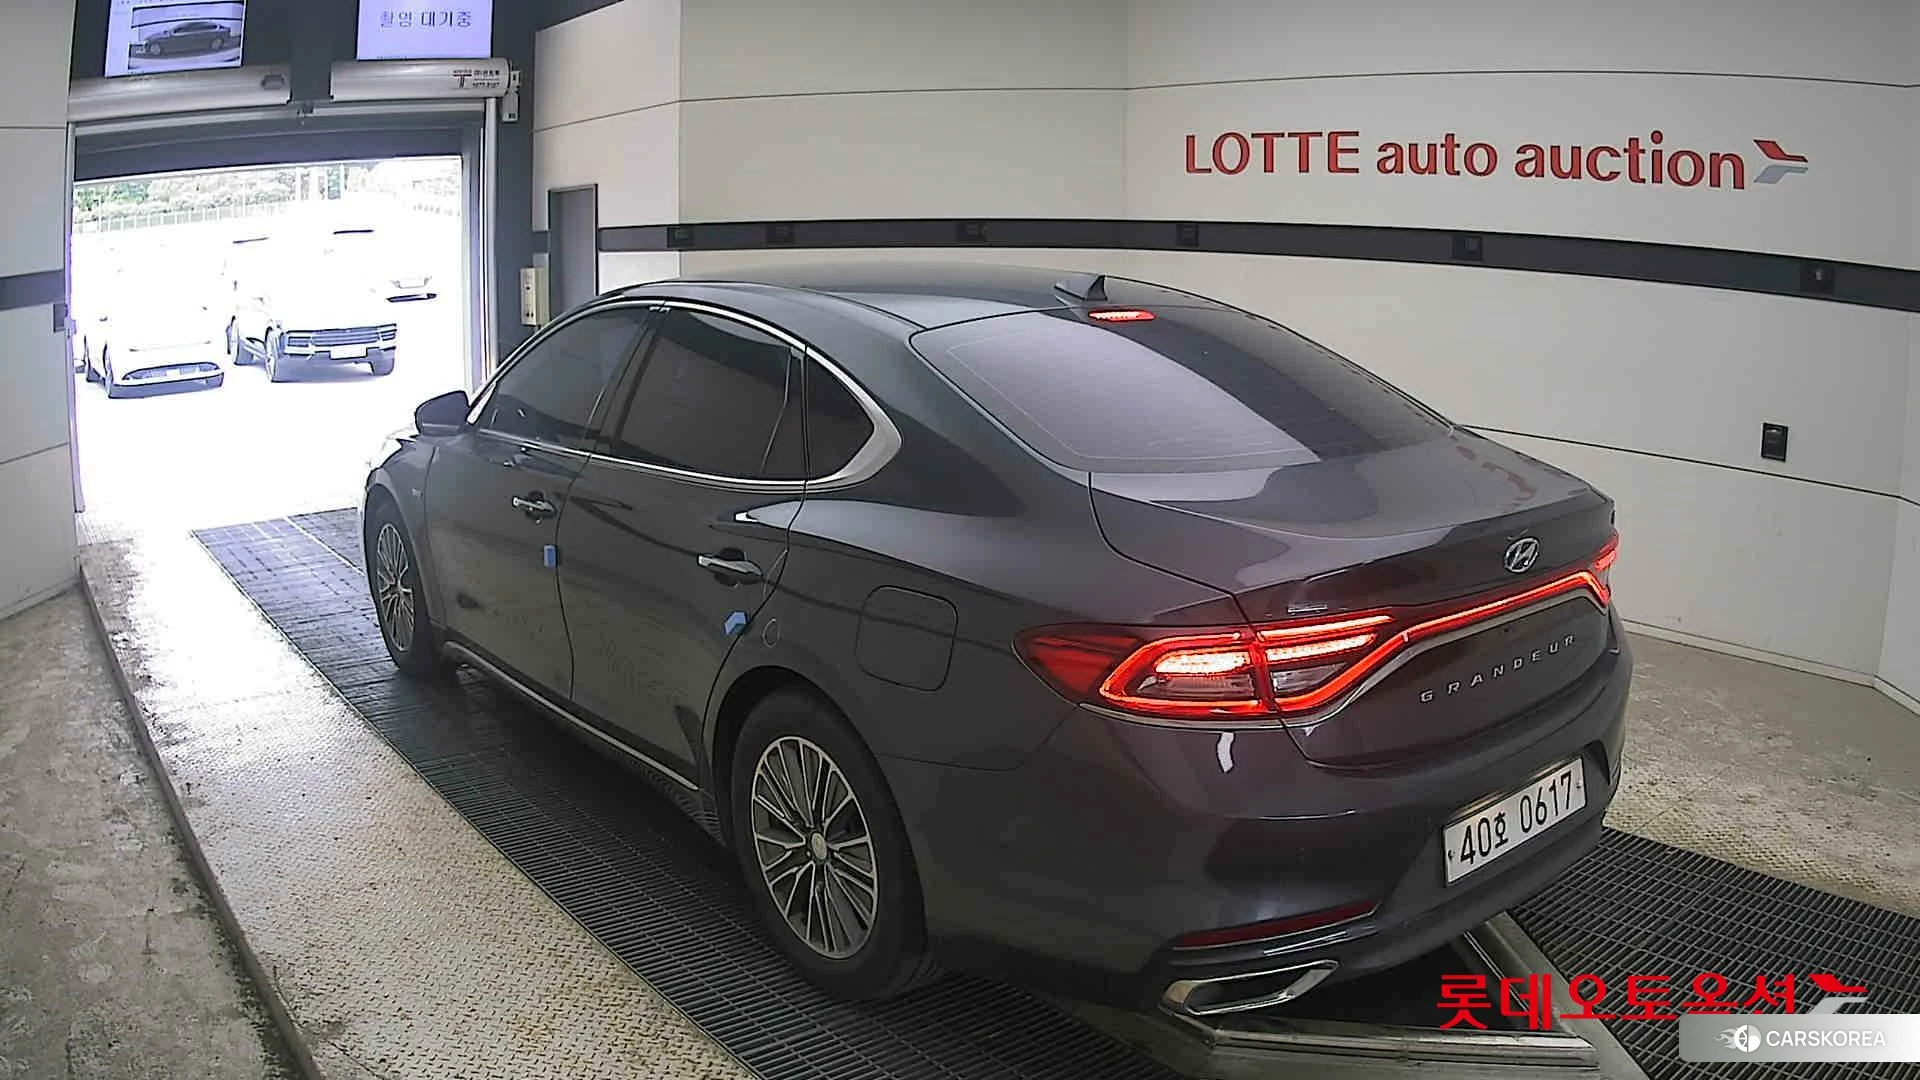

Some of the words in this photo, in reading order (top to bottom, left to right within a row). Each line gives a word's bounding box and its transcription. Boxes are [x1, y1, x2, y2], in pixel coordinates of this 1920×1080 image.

[421, 9, 473, 28] 대기중
[1185, 131, 1360, 175] LOTTE
[1377, 131, 1498, 177] auto
[1514, 130, 1746, 190] auction
[1419, 634, 1575, 702] GRANDEUR
[1460, 811, 1509, 865] 40호
[1519, 770, 1573, 834] 0617
